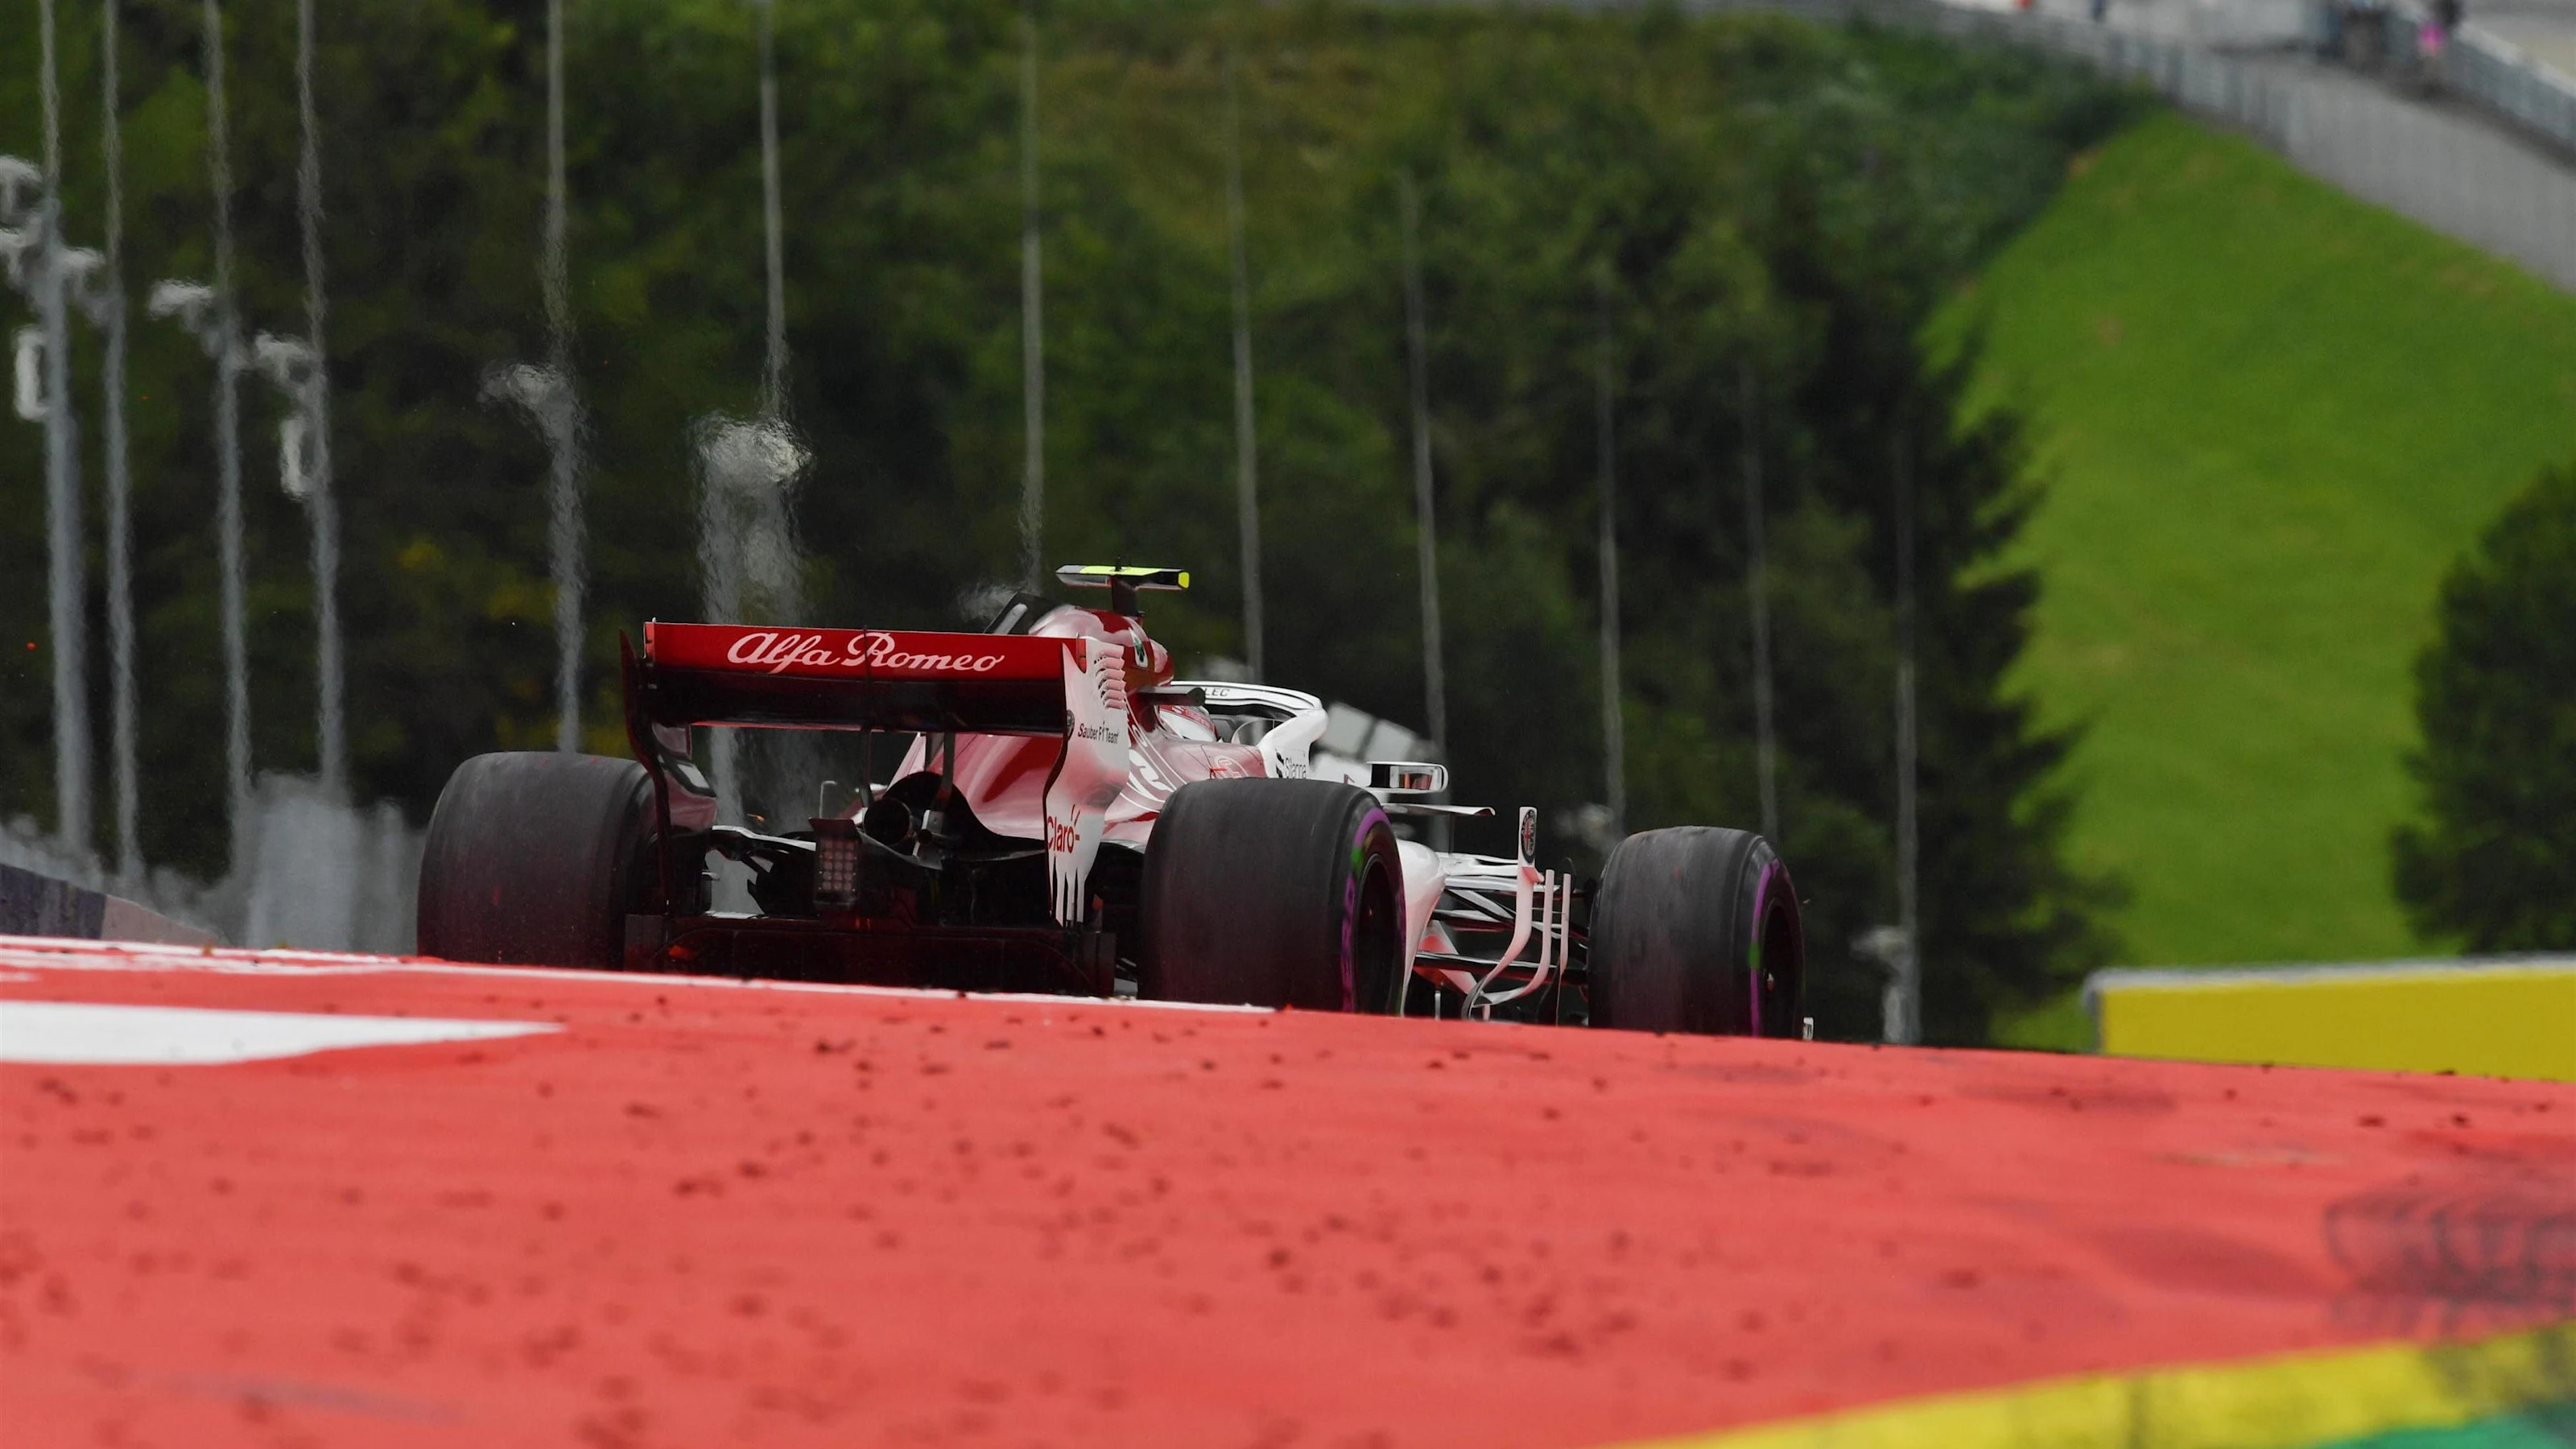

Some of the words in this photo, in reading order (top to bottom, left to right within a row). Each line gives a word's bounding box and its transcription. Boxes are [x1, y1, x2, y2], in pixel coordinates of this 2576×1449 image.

[727, 632, 840, 674] Alfa
[840, 632, 1005, 672] Romeo
[1077, 723, 1097, 741] Sauber
[1105, 728, 1119, 744] Team
[1047, 815, 1075, 853] Claro
